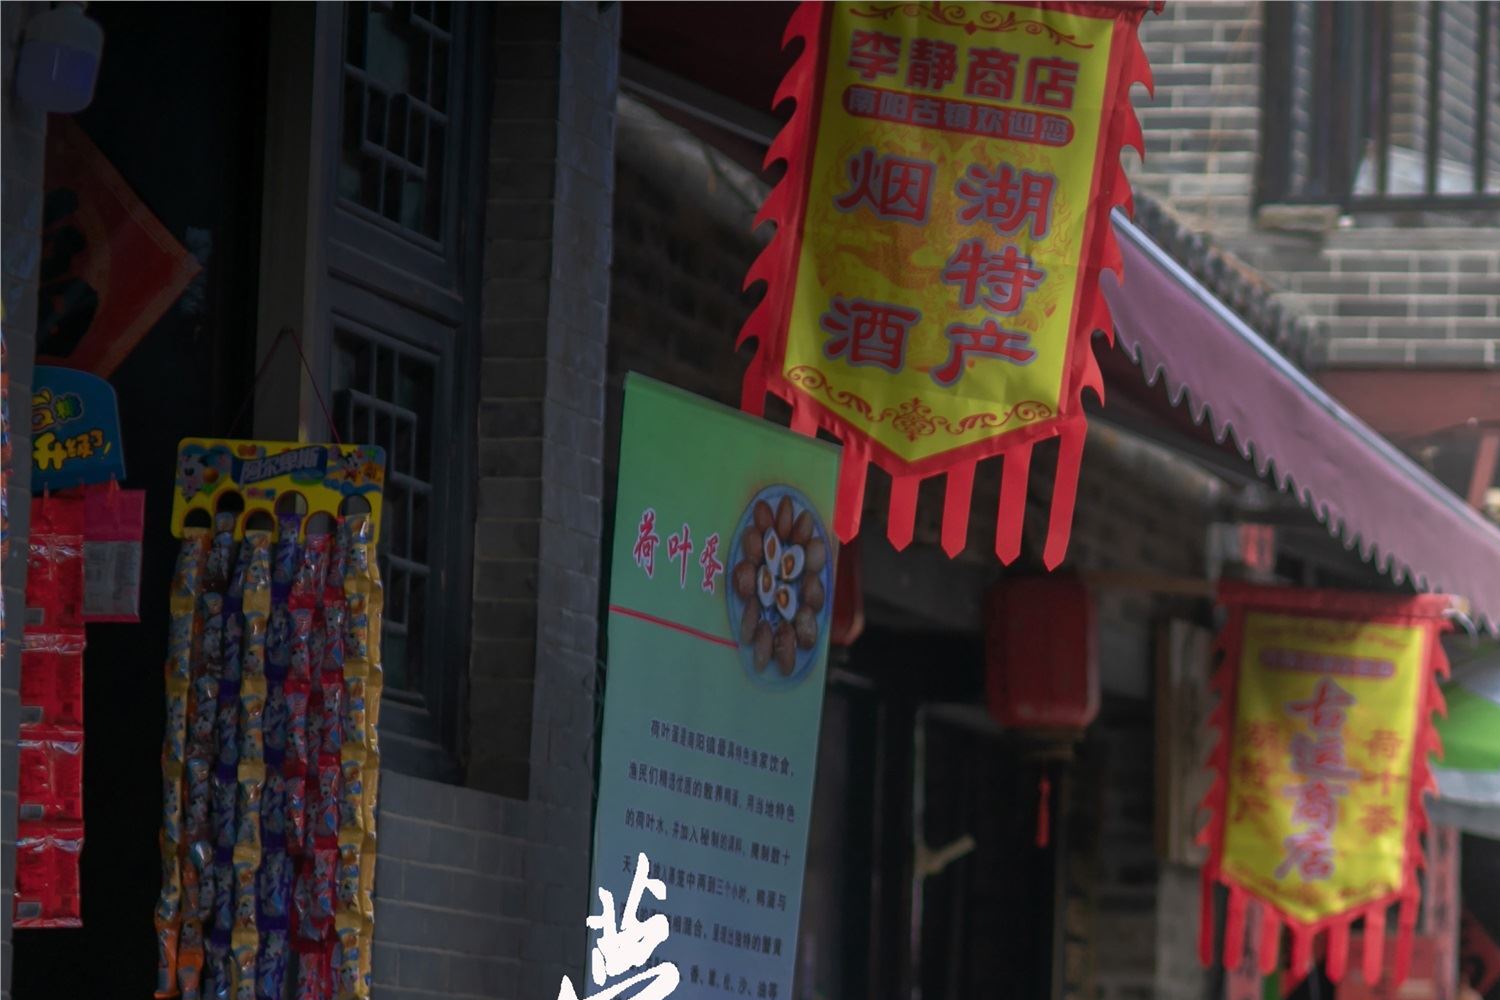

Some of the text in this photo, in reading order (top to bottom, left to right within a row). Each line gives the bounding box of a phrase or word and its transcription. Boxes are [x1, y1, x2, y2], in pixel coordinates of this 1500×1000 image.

[847, 29, 1080, 110] 李静商店
[819, 146, 938, 374] 烟酒
[929, 162, 1058, 388] 湖特产
[633, 507, 724, 593] 荷叶蛋
